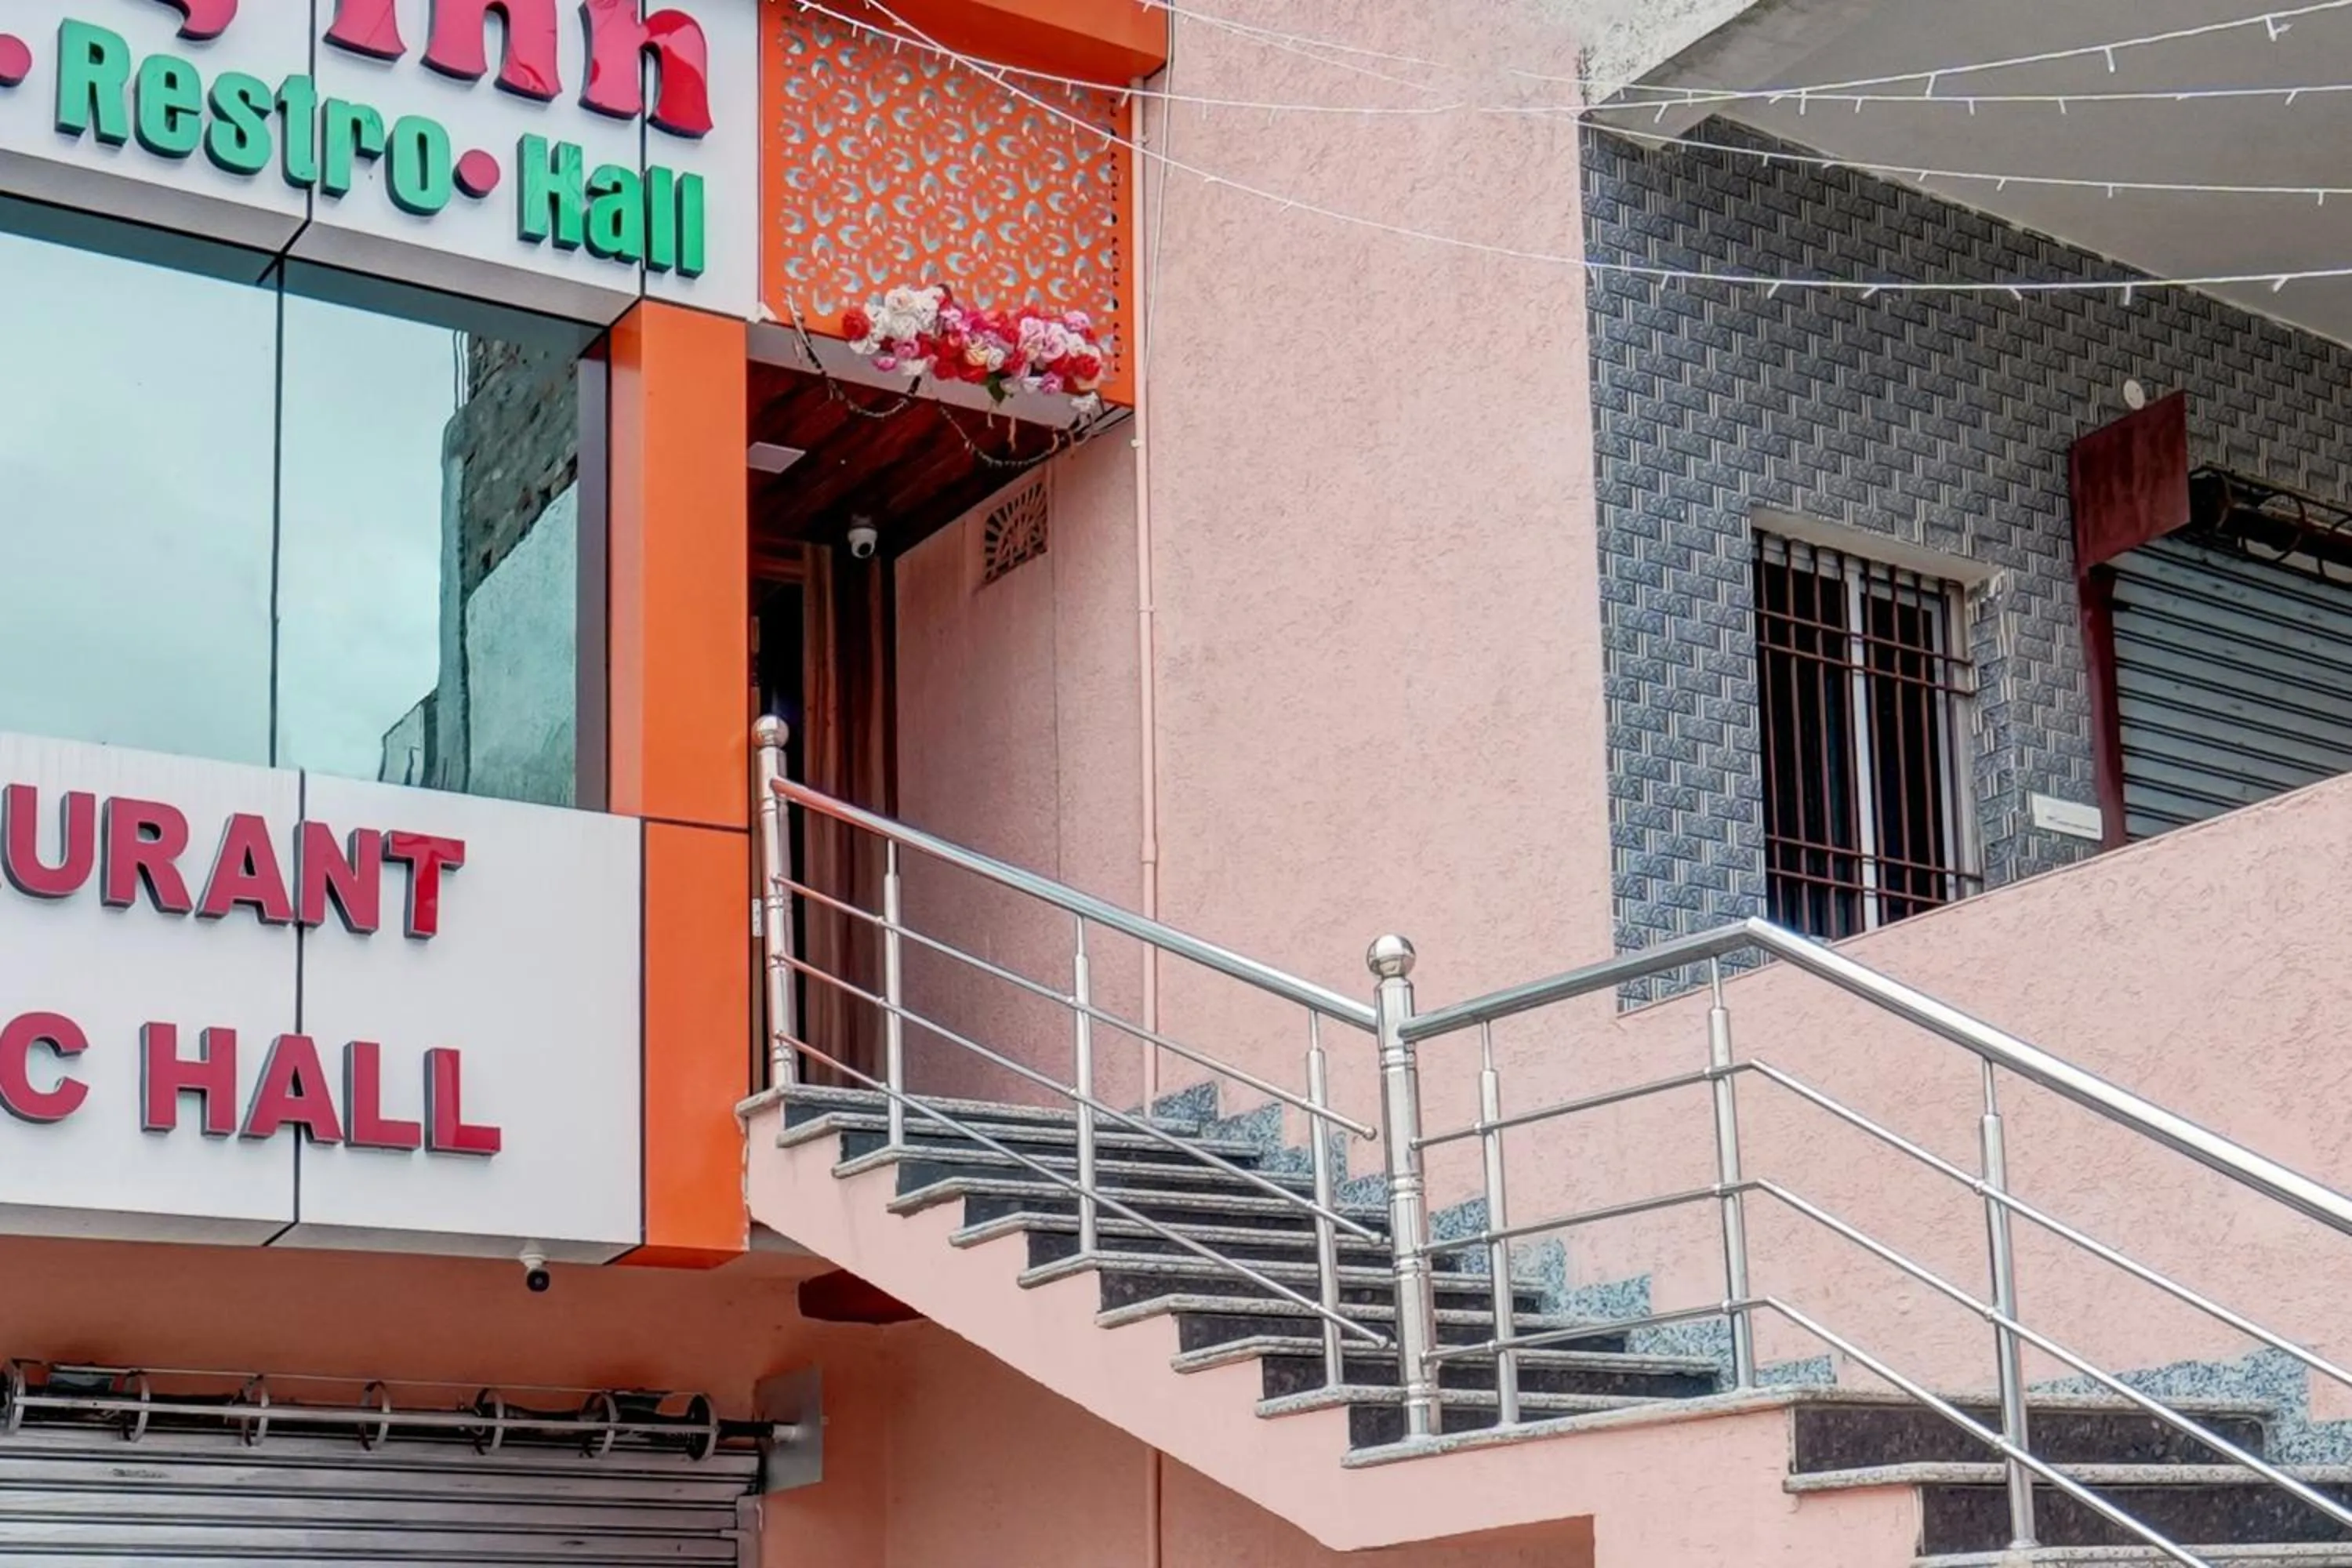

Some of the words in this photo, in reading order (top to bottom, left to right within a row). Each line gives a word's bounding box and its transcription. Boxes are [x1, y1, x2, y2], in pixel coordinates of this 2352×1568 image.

[55, 17, 452, 216] Restro
[517, 132, 705, 280] Hall
[140, 1022, 502, 1156] HALL
